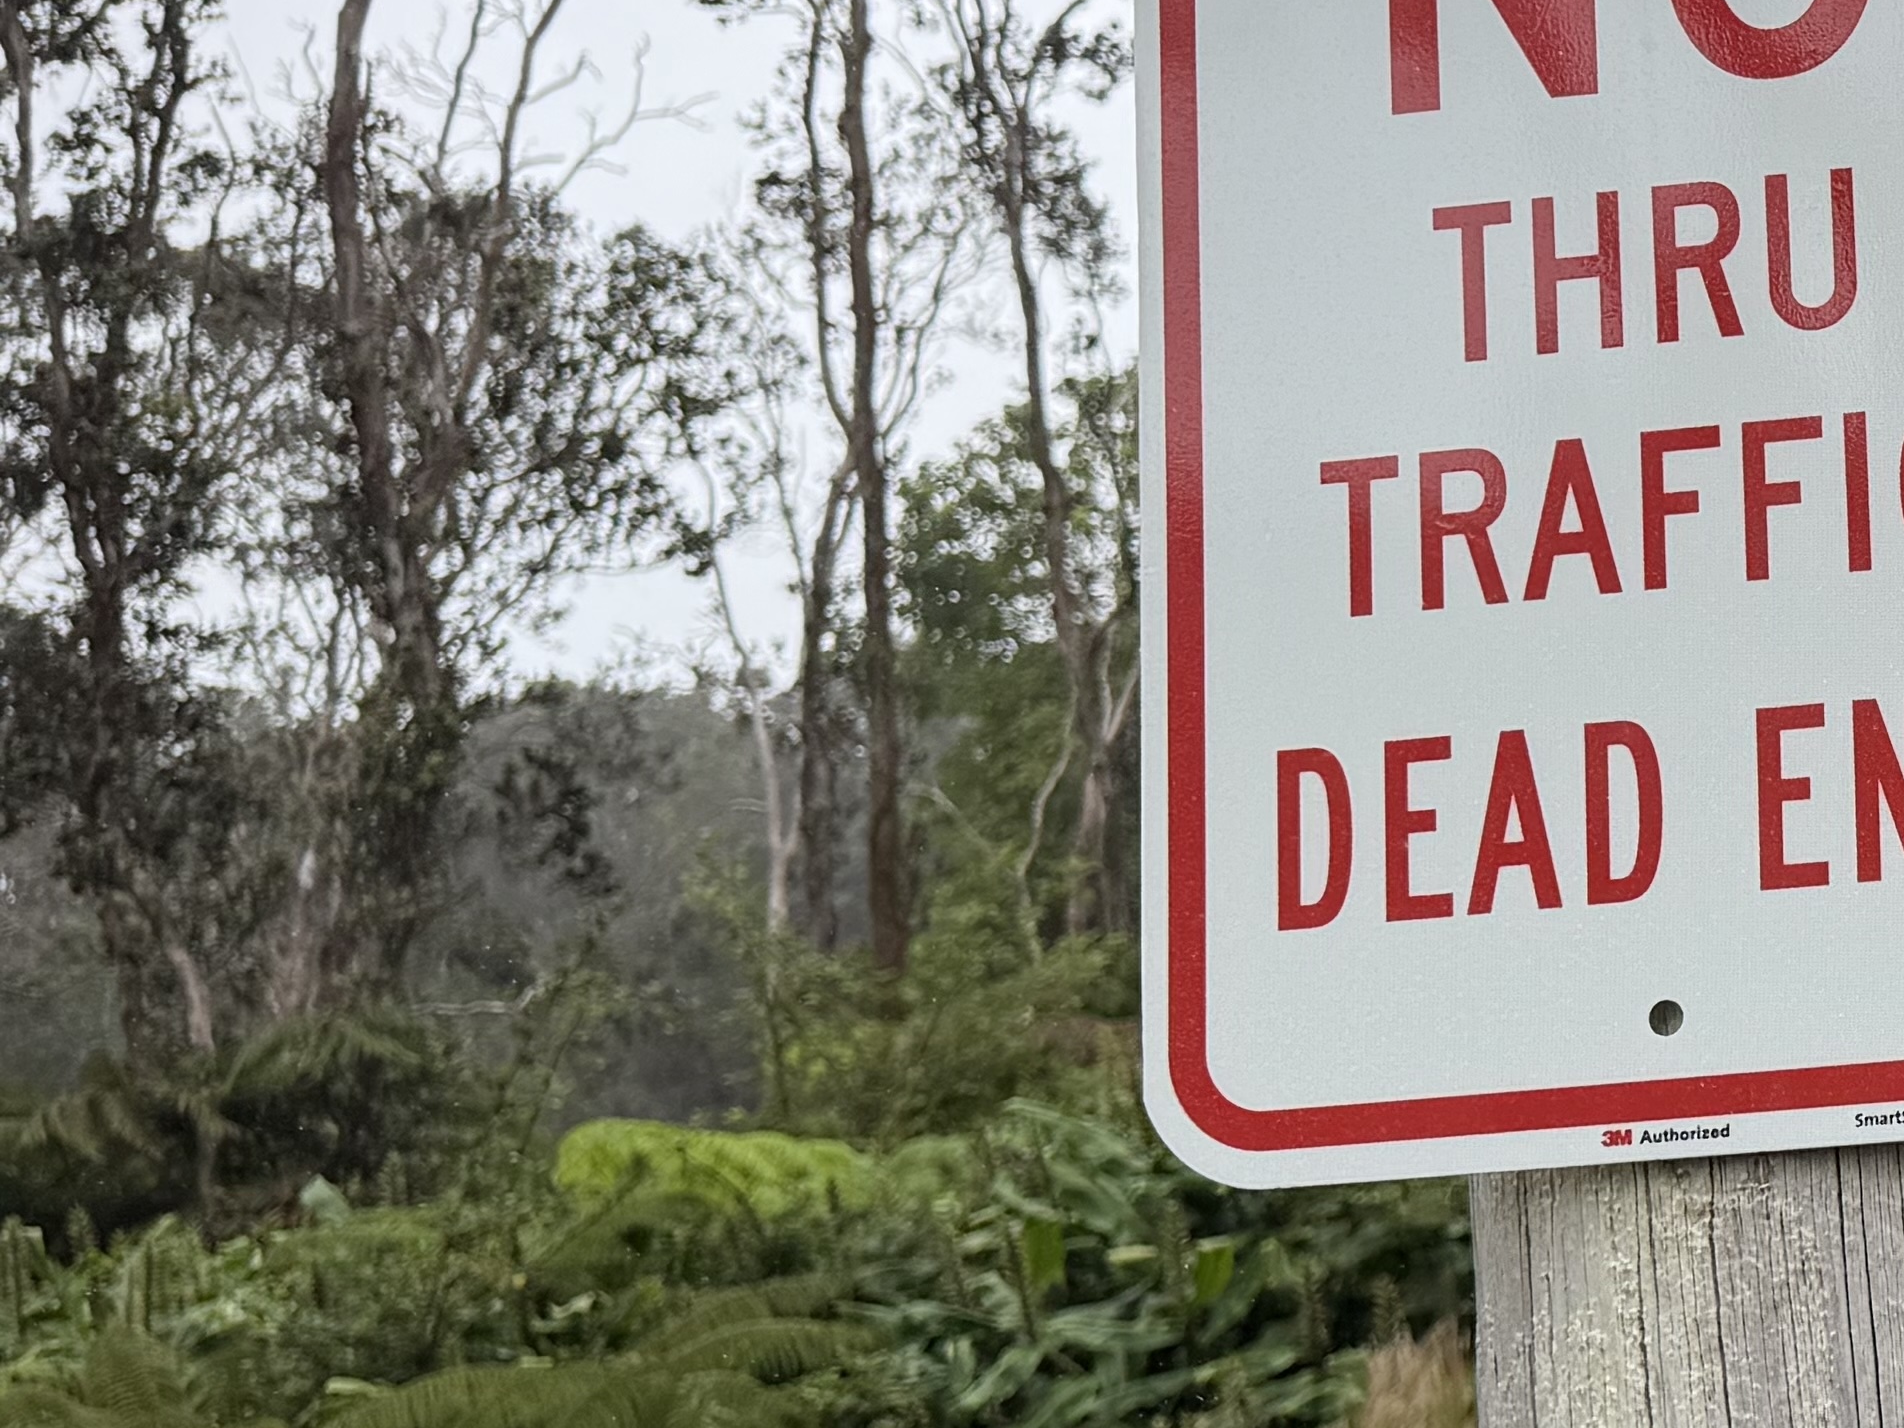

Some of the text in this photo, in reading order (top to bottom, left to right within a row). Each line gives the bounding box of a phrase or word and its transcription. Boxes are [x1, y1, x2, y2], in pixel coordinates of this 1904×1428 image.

[1434, 169, 1857, 360] THRU
[1277, 722, 1663, 931] DEAD
[1601, 1123, 1729, 1147] 3M Authorized
